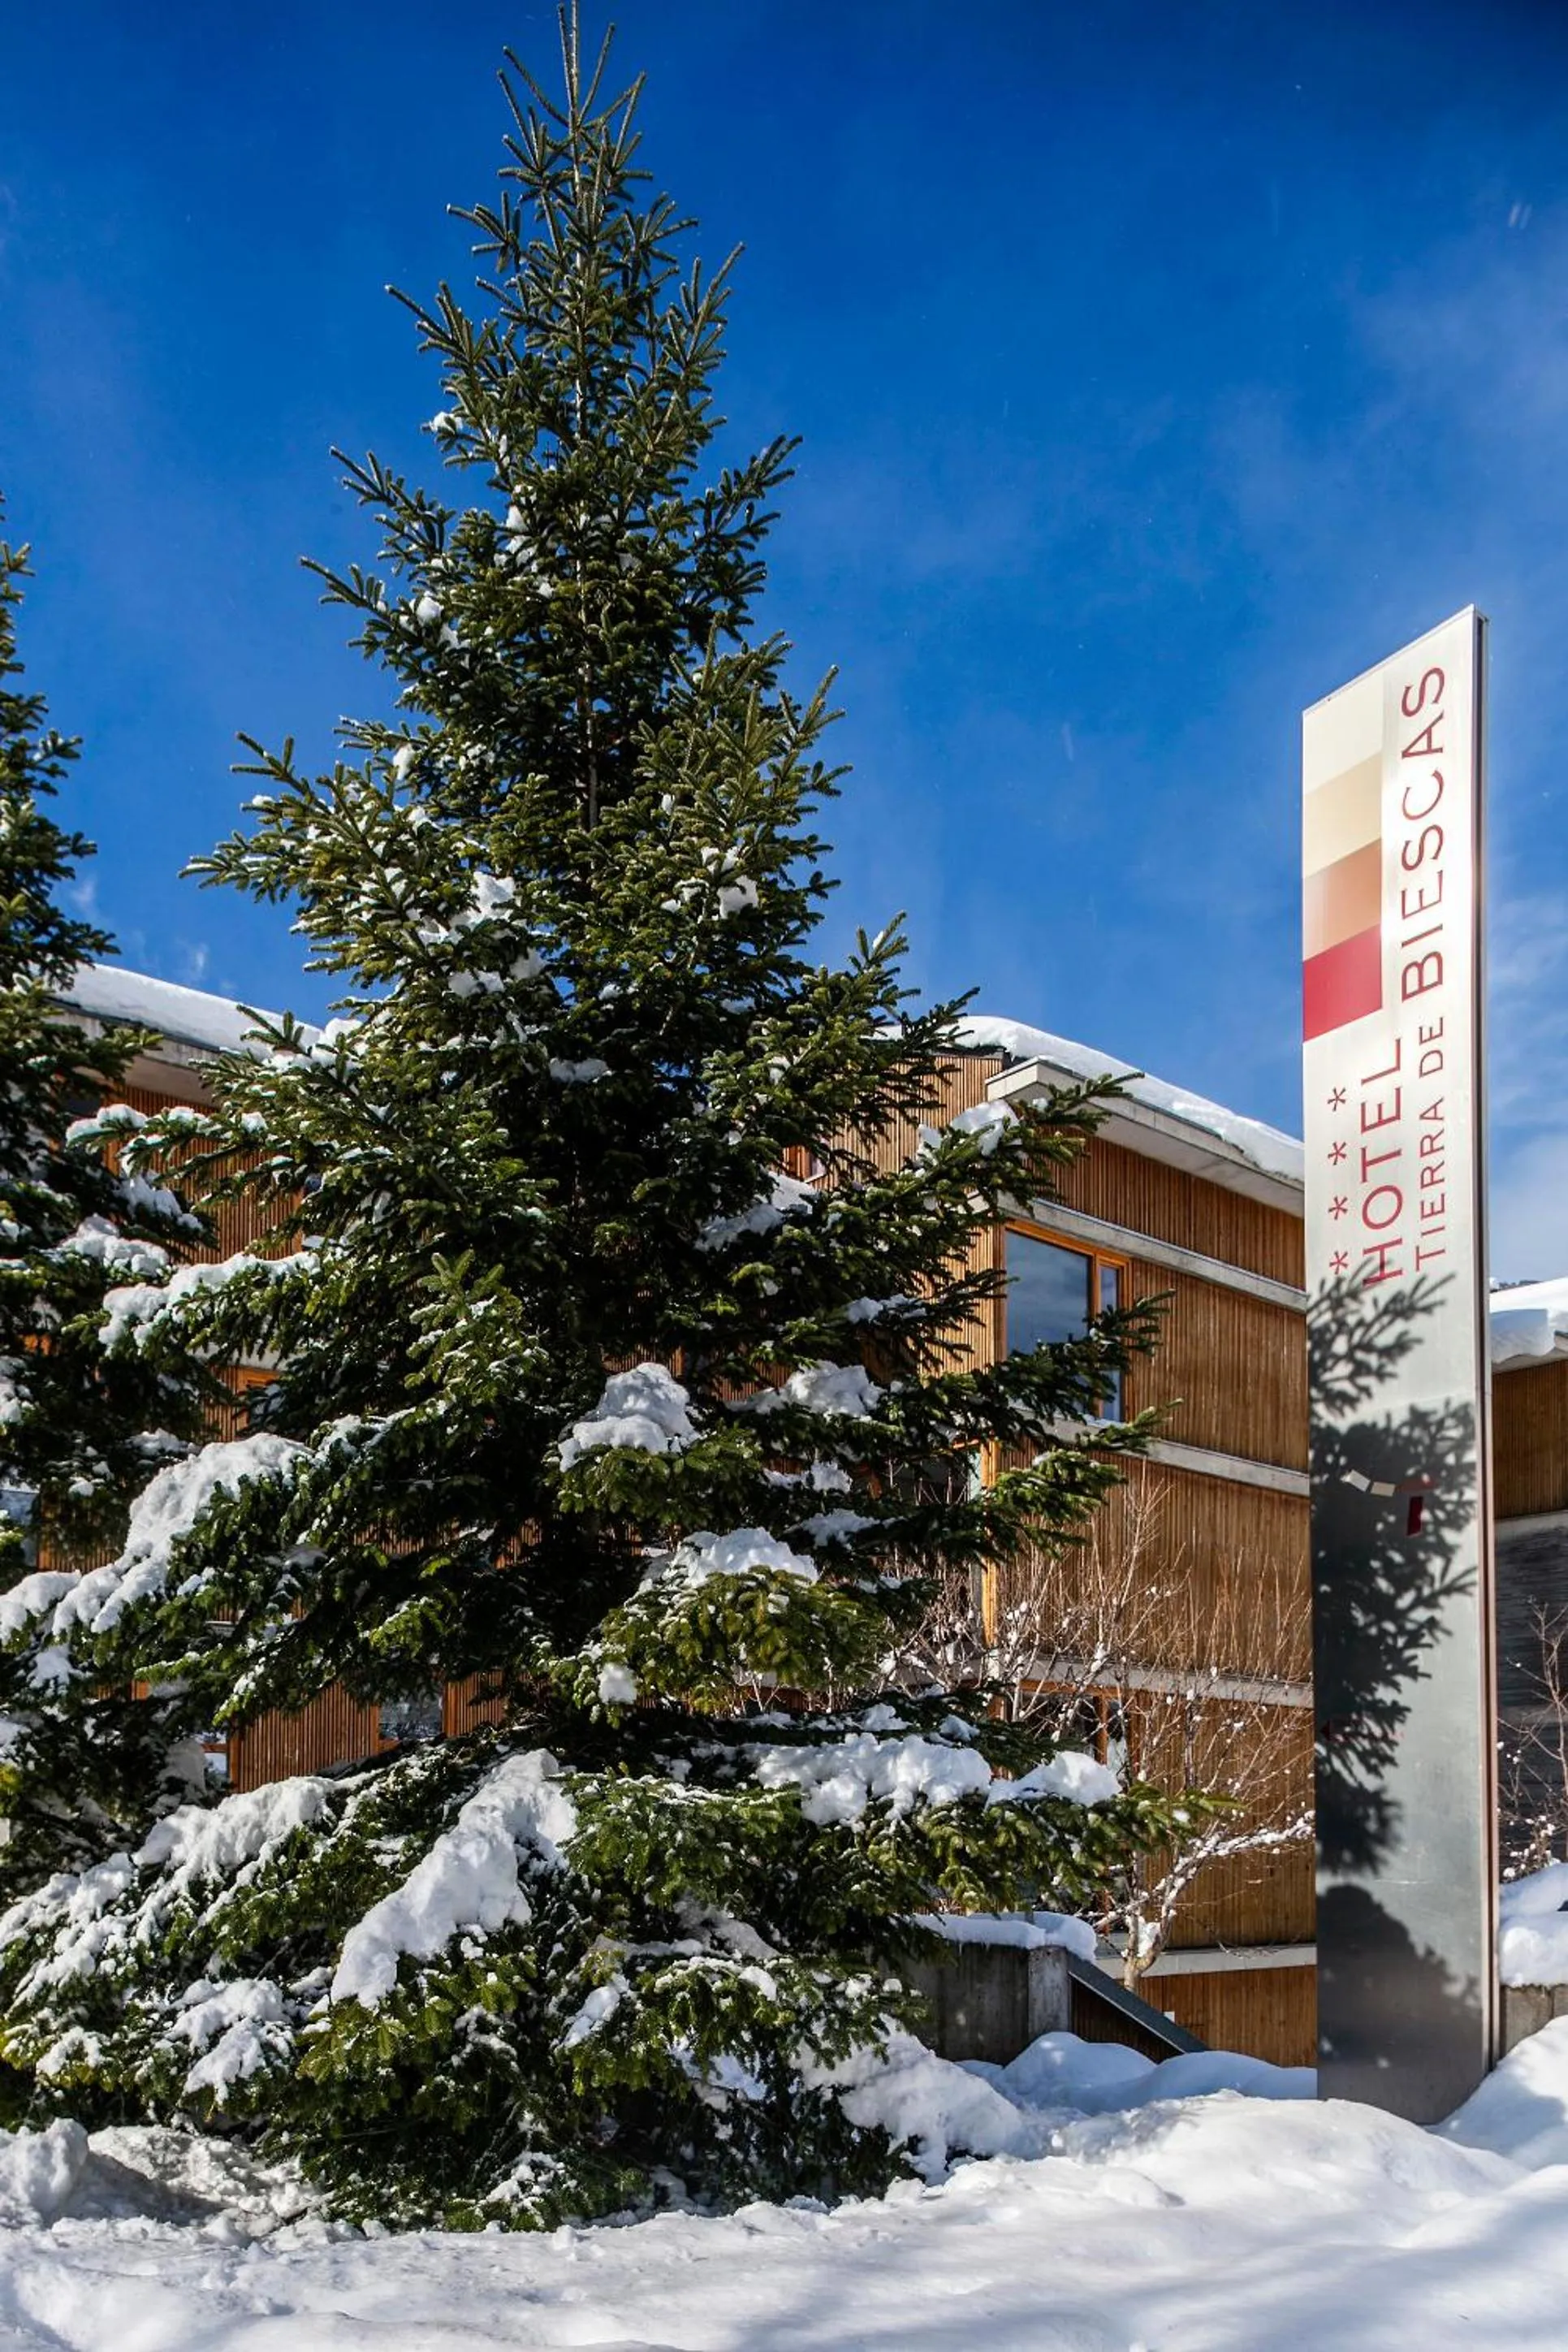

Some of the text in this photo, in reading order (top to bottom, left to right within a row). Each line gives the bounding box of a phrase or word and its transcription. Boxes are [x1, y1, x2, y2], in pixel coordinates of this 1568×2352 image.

[1361, 1038, 1402, 1286] HOTEL
[1401, 667, 1445, 1272] TIERRA DE BIESCAS
